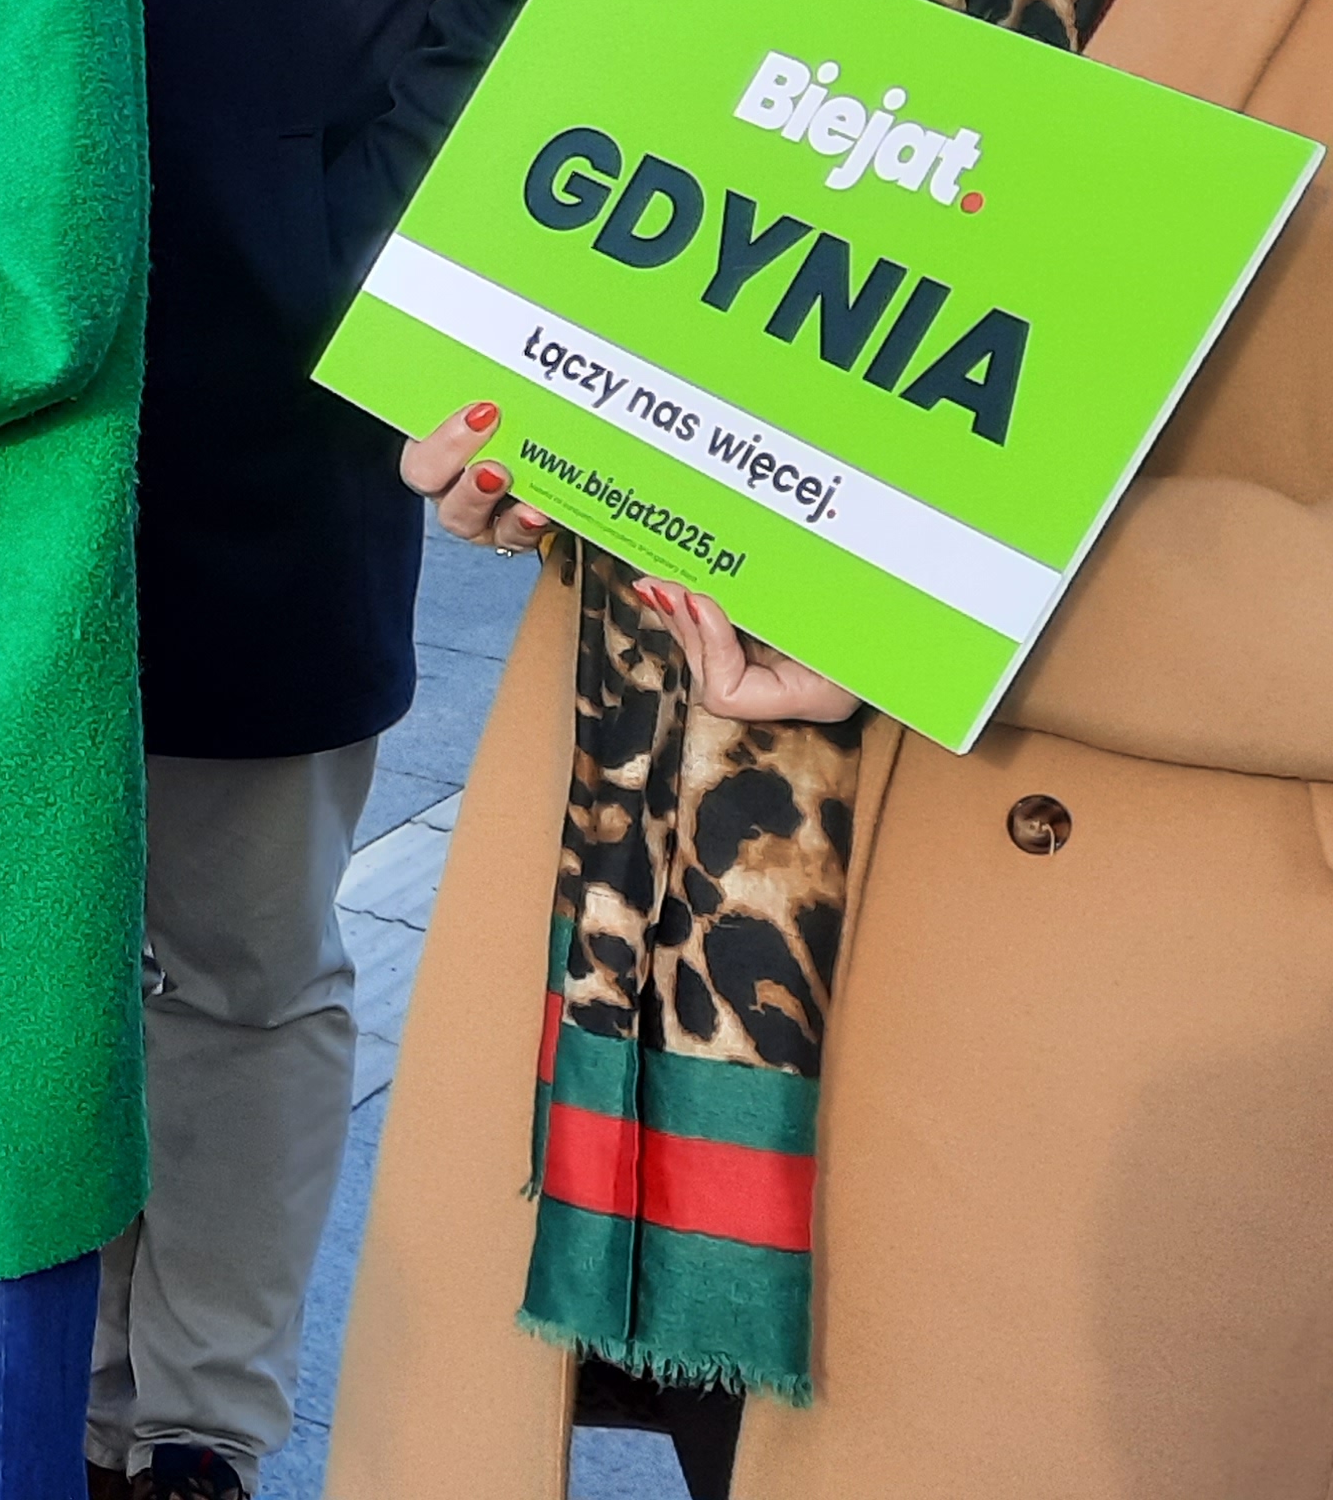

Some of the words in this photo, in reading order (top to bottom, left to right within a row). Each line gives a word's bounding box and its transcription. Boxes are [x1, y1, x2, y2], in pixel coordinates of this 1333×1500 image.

[733, 49, 985, 216] Biejat.
[523, 126, 1031, 448] GDYNIA
[519, 438, 746, 578] www.biejat2025.pl
[523, 326, 629, 404] Łączy
[629, 386, 700, 443] nas
[707, 425, 840, 523] więcej.
